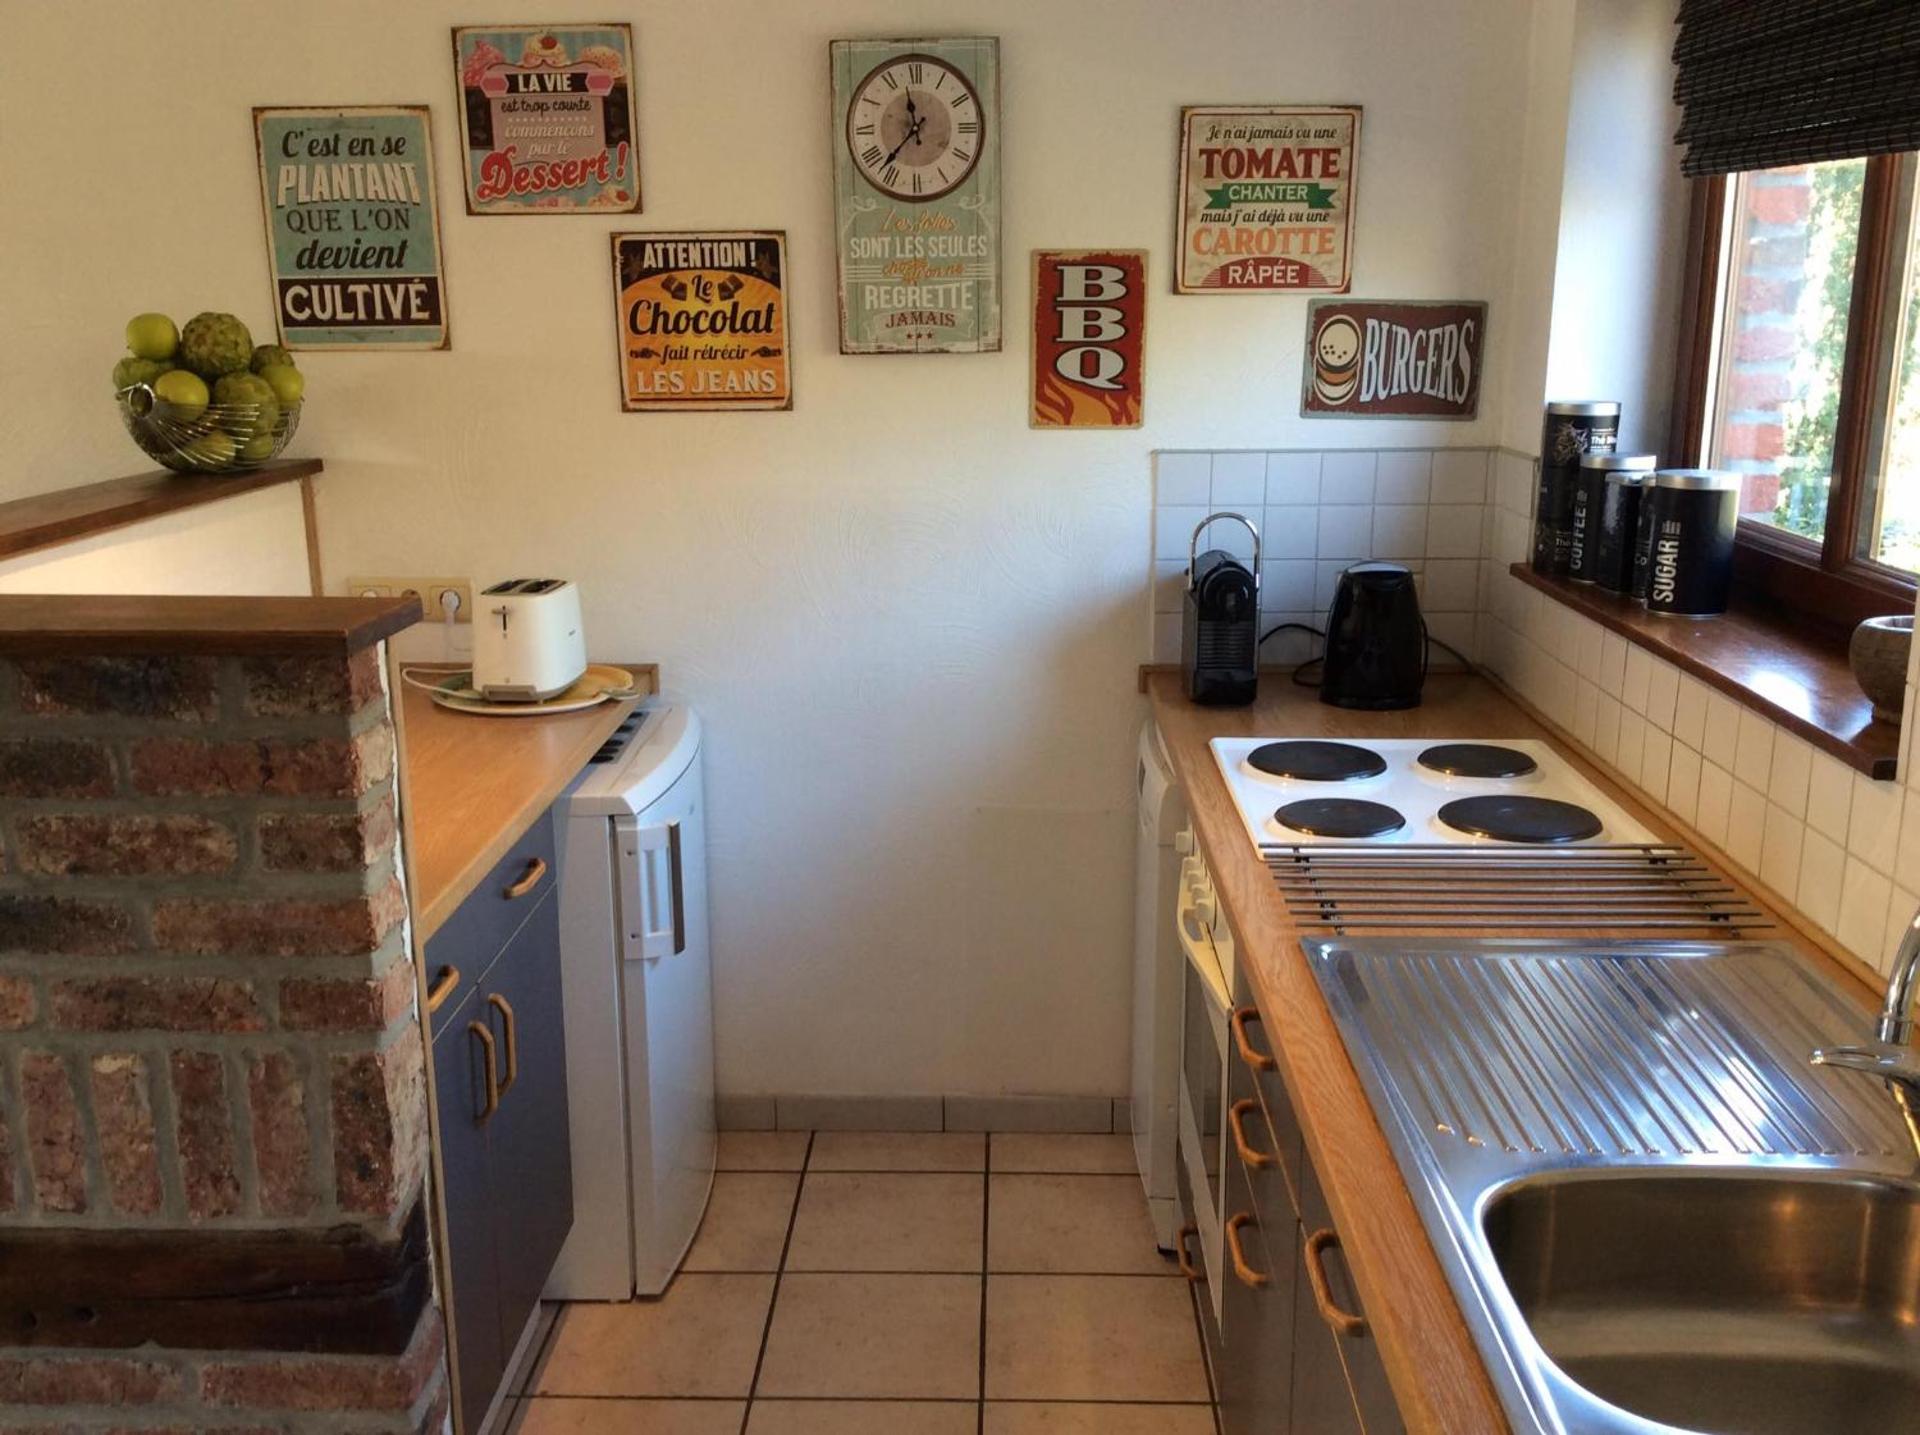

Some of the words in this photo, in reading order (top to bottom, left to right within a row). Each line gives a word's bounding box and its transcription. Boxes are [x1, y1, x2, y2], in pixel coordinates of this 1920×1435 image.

[518, 74, 540, 92] LA
[543, 73, 573, 92] VIE
[501, 98, 519, 112] est
[521, 98, 550, 117] trop
[553, 98, 592, 111] courte
[282, 129, 340, 158] C'est
[348, 135, 375, 156] en
[382, 135, 406, 156] se
[1206, 125, 1219, 142] Je
[1246, 126, 1293, 143] jamais
[1314, 128, 1337, 139] une
[1199, 147, 1341, 179] TOMATE
[276, 162, 421, 208] PLANTANT
[1228, 185, 1308, 200] CHANTER
[286, 209, 341, 234] QUE
[353, 208, 410, 231] L'ON
[1200, 210, 1232, 223] mais
[1289, 211, 1304, 222] vu
[1306, 211, 1330, 222] une
[296, 238, 408, 270] devient
[850, 237, 891, 258] SONT
[896, 236, 924, 258] LES
[928, 235, 988, 257] SEULES
[1192, 226, 1336, 256] CAROTTE
[1228, 259, 1300, 284] RÂPÉE
[285, 279, 430, 320] CULTIVÉ
[691, 274, 713, 304] Le
[864, 281, 974, 310] REGRETTE
[629, 299, 777, 335] Chocolat
[885, 311, 956, 328] JAMAIS
[660, 344, 689, 365] fait
[1359, 318, 1475, 405] BURGERS
[637, 369, 686, 395] LES
[691, 369, 778, 394] JEANS
[1653, 538, 1680, 603] SUGAR
